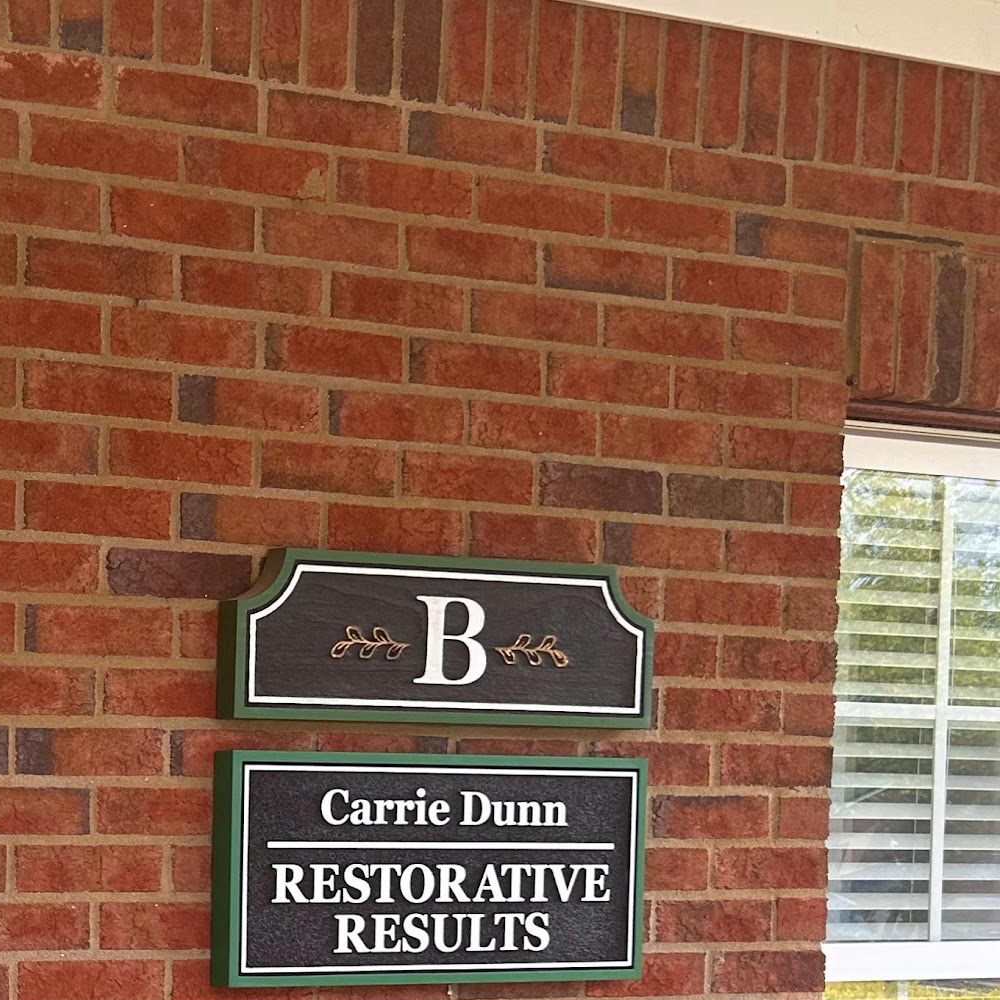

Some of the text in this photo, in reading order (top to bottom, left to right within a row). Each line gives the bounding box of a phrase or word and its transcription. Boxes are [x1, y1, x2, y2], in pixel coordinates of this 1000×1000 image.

[413, 595, 487, 686] B
[320, 787, 568, 827] Carrie Dunn
[271, 863, 611, 904] RESTORATIVE
[333, 912, 550, 954] RESULTS
